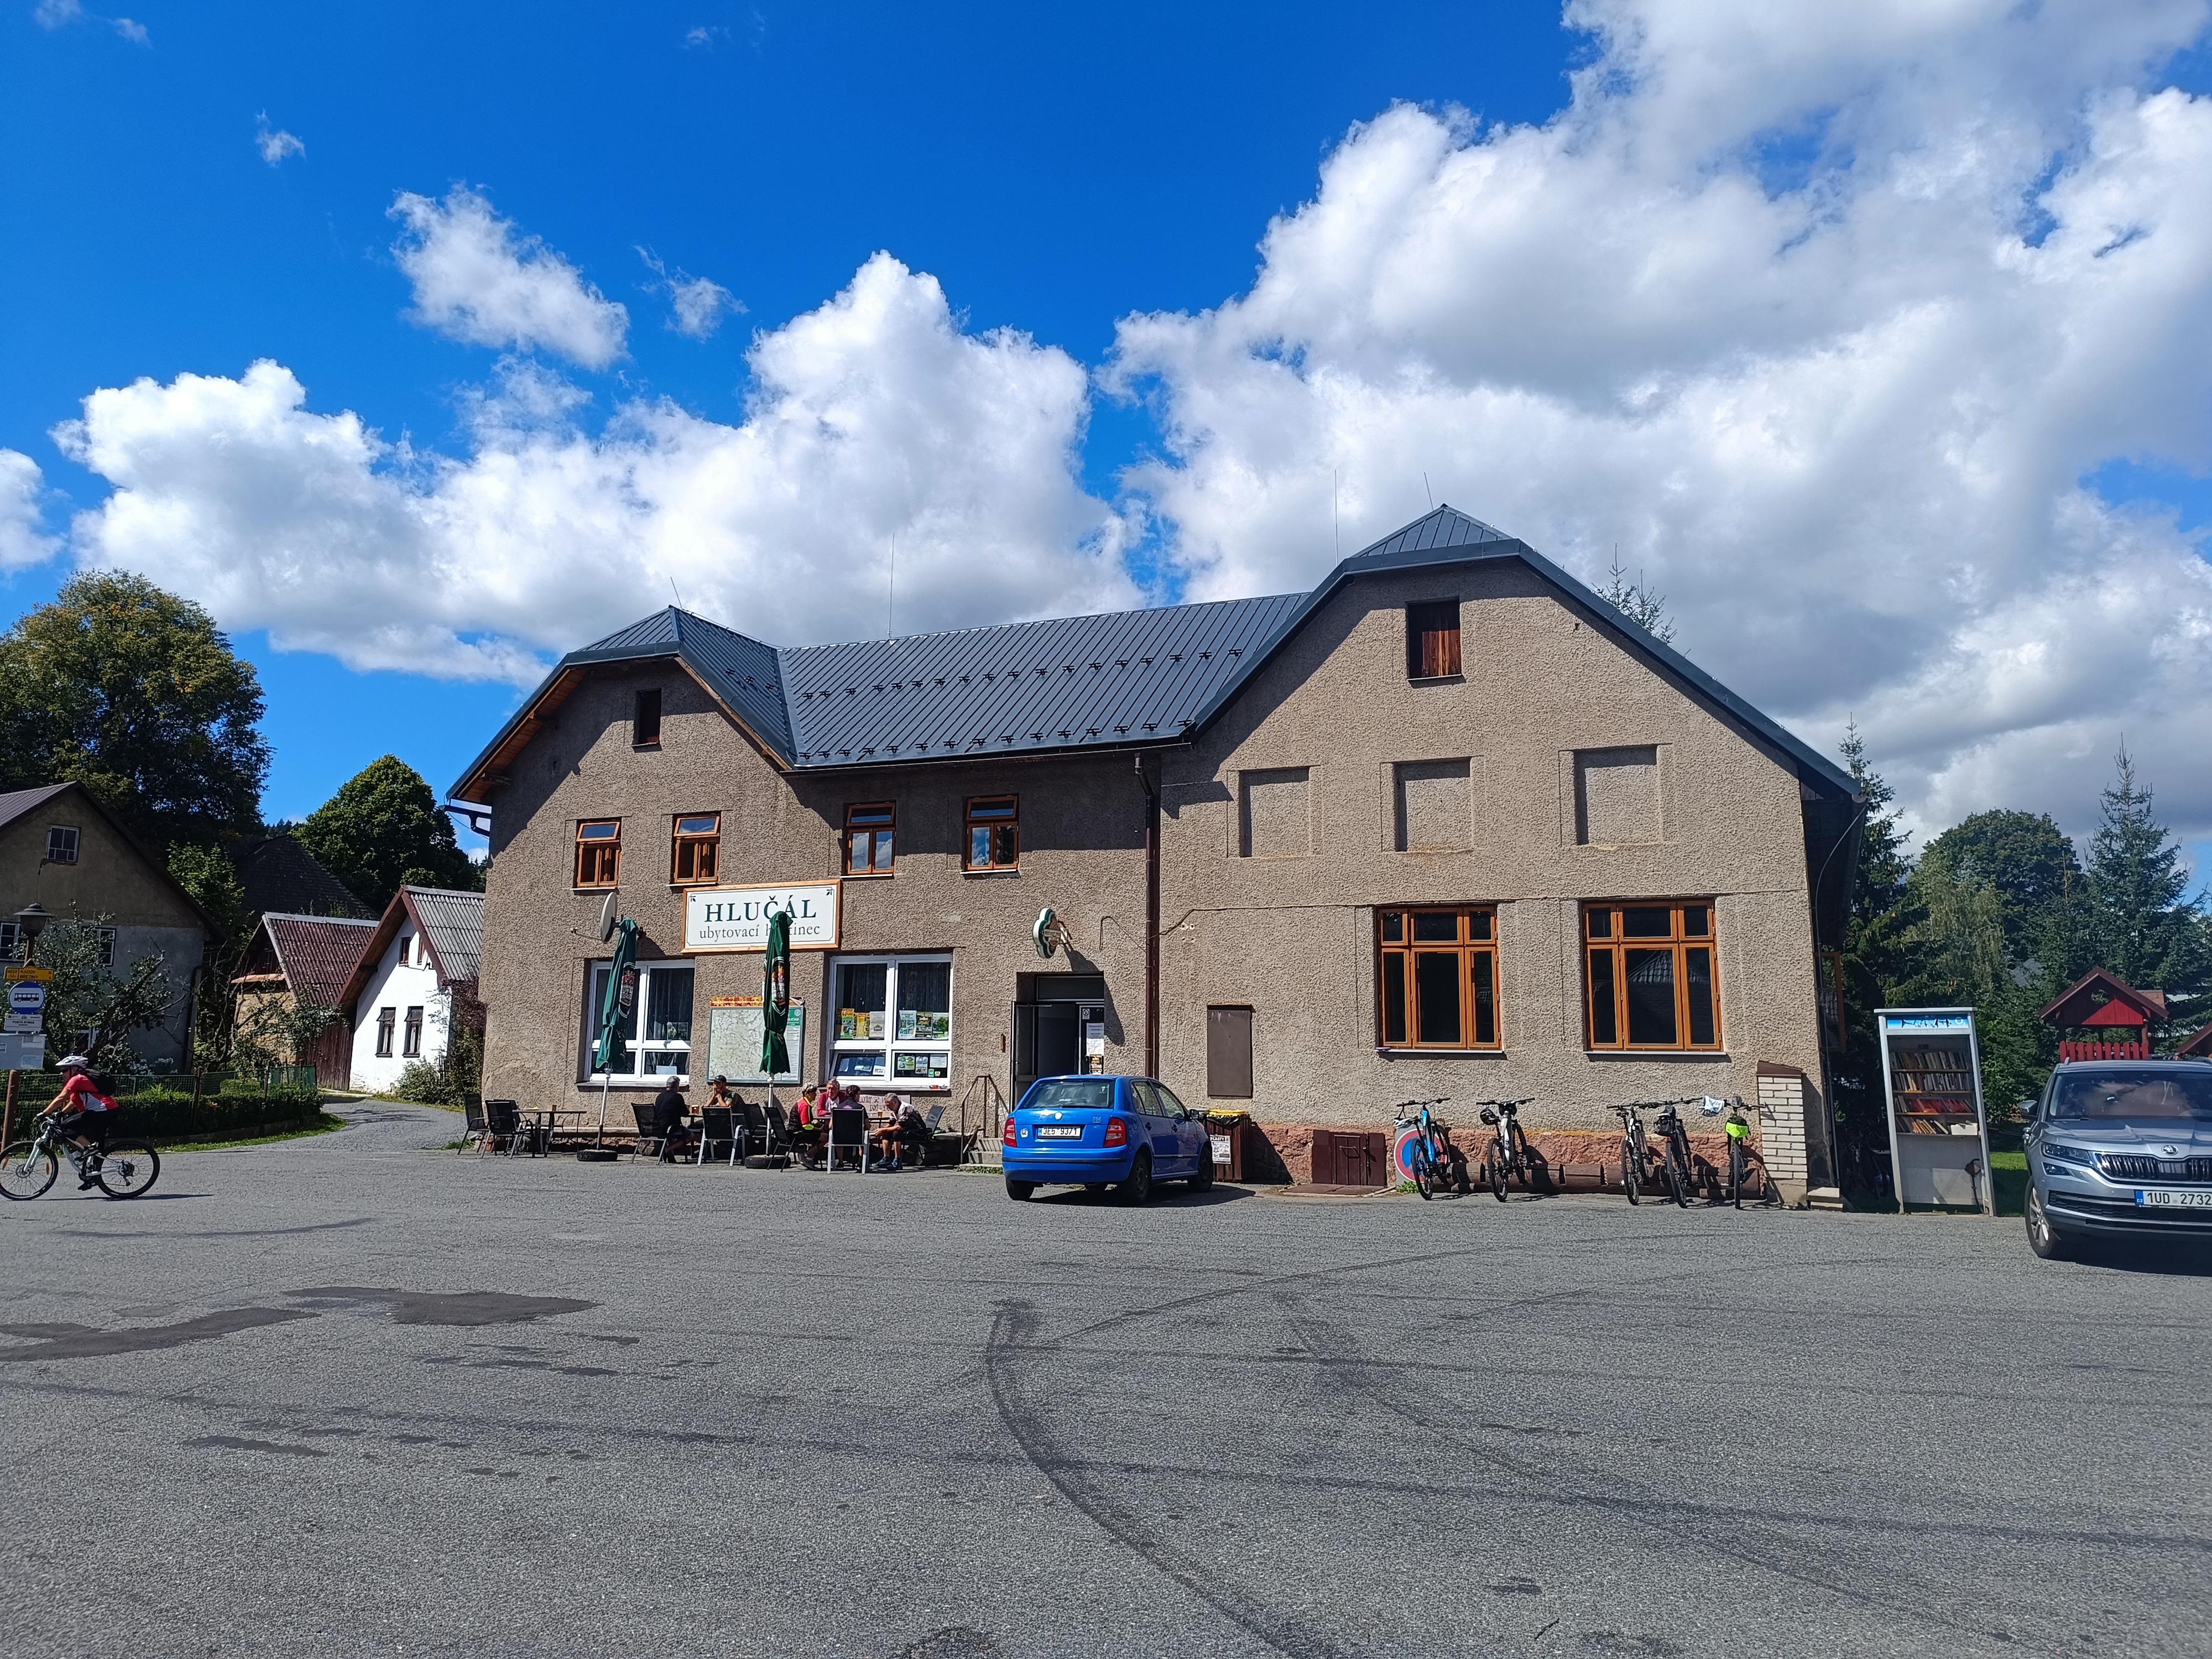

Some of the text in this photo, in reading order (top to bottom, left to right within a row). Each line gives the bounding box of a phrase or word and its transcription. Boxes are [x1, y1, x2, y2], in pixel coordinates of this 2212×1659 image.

[704, 895, 817, 922] HLUČÁL
[699, 923, 820, 942] ubytovací htinec
[1043, 1127, 1055, 1135] 3E5
[1060, 1127, 1077, 1135] 9371
[2147, 1192, 2212, 1206] 1UD 2732
